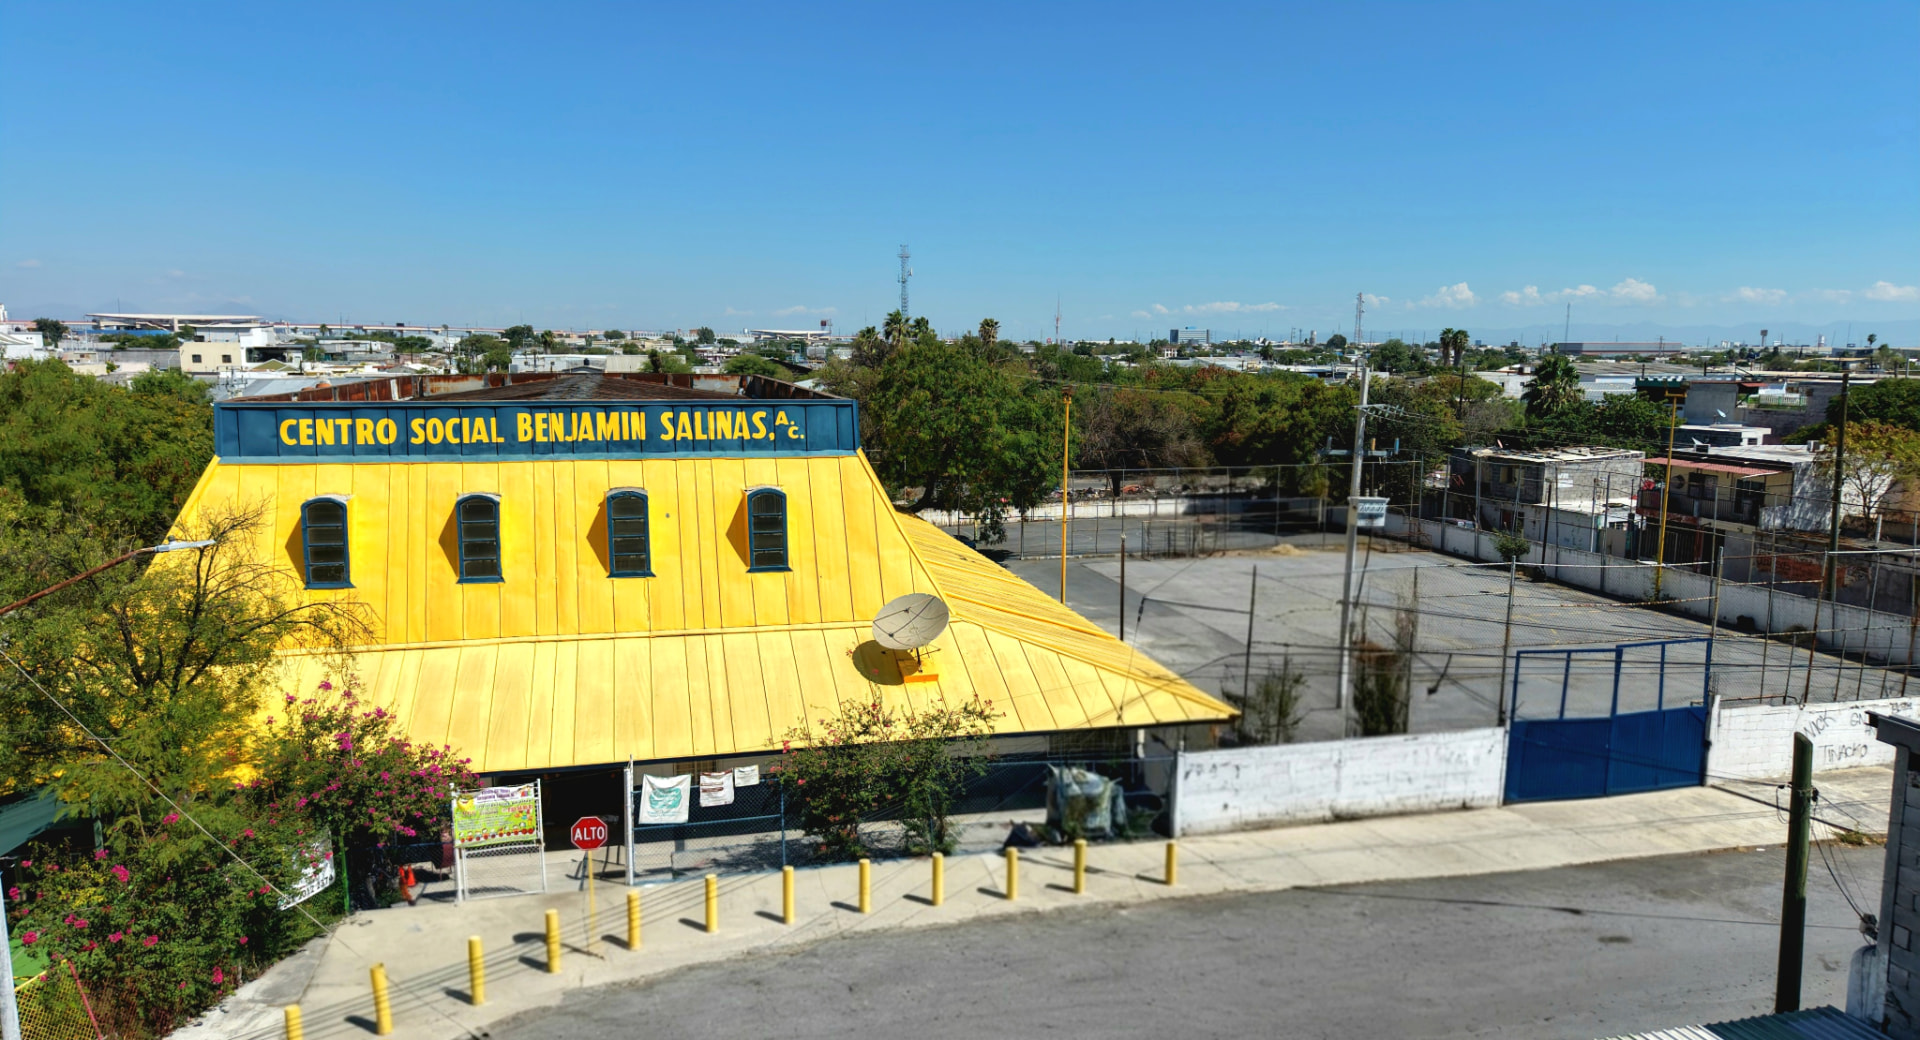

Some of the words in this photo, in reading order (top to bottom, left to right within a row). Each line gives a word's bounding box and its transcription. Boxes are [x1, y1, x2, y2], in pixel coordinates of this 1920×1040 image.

[279, 418, 398, 446] CENTRO
[410, 417, 505, 445] SOCIAL
[517, 411, 646, 442] BENJAMIN
[574, 826, 605, 840] ALTO
